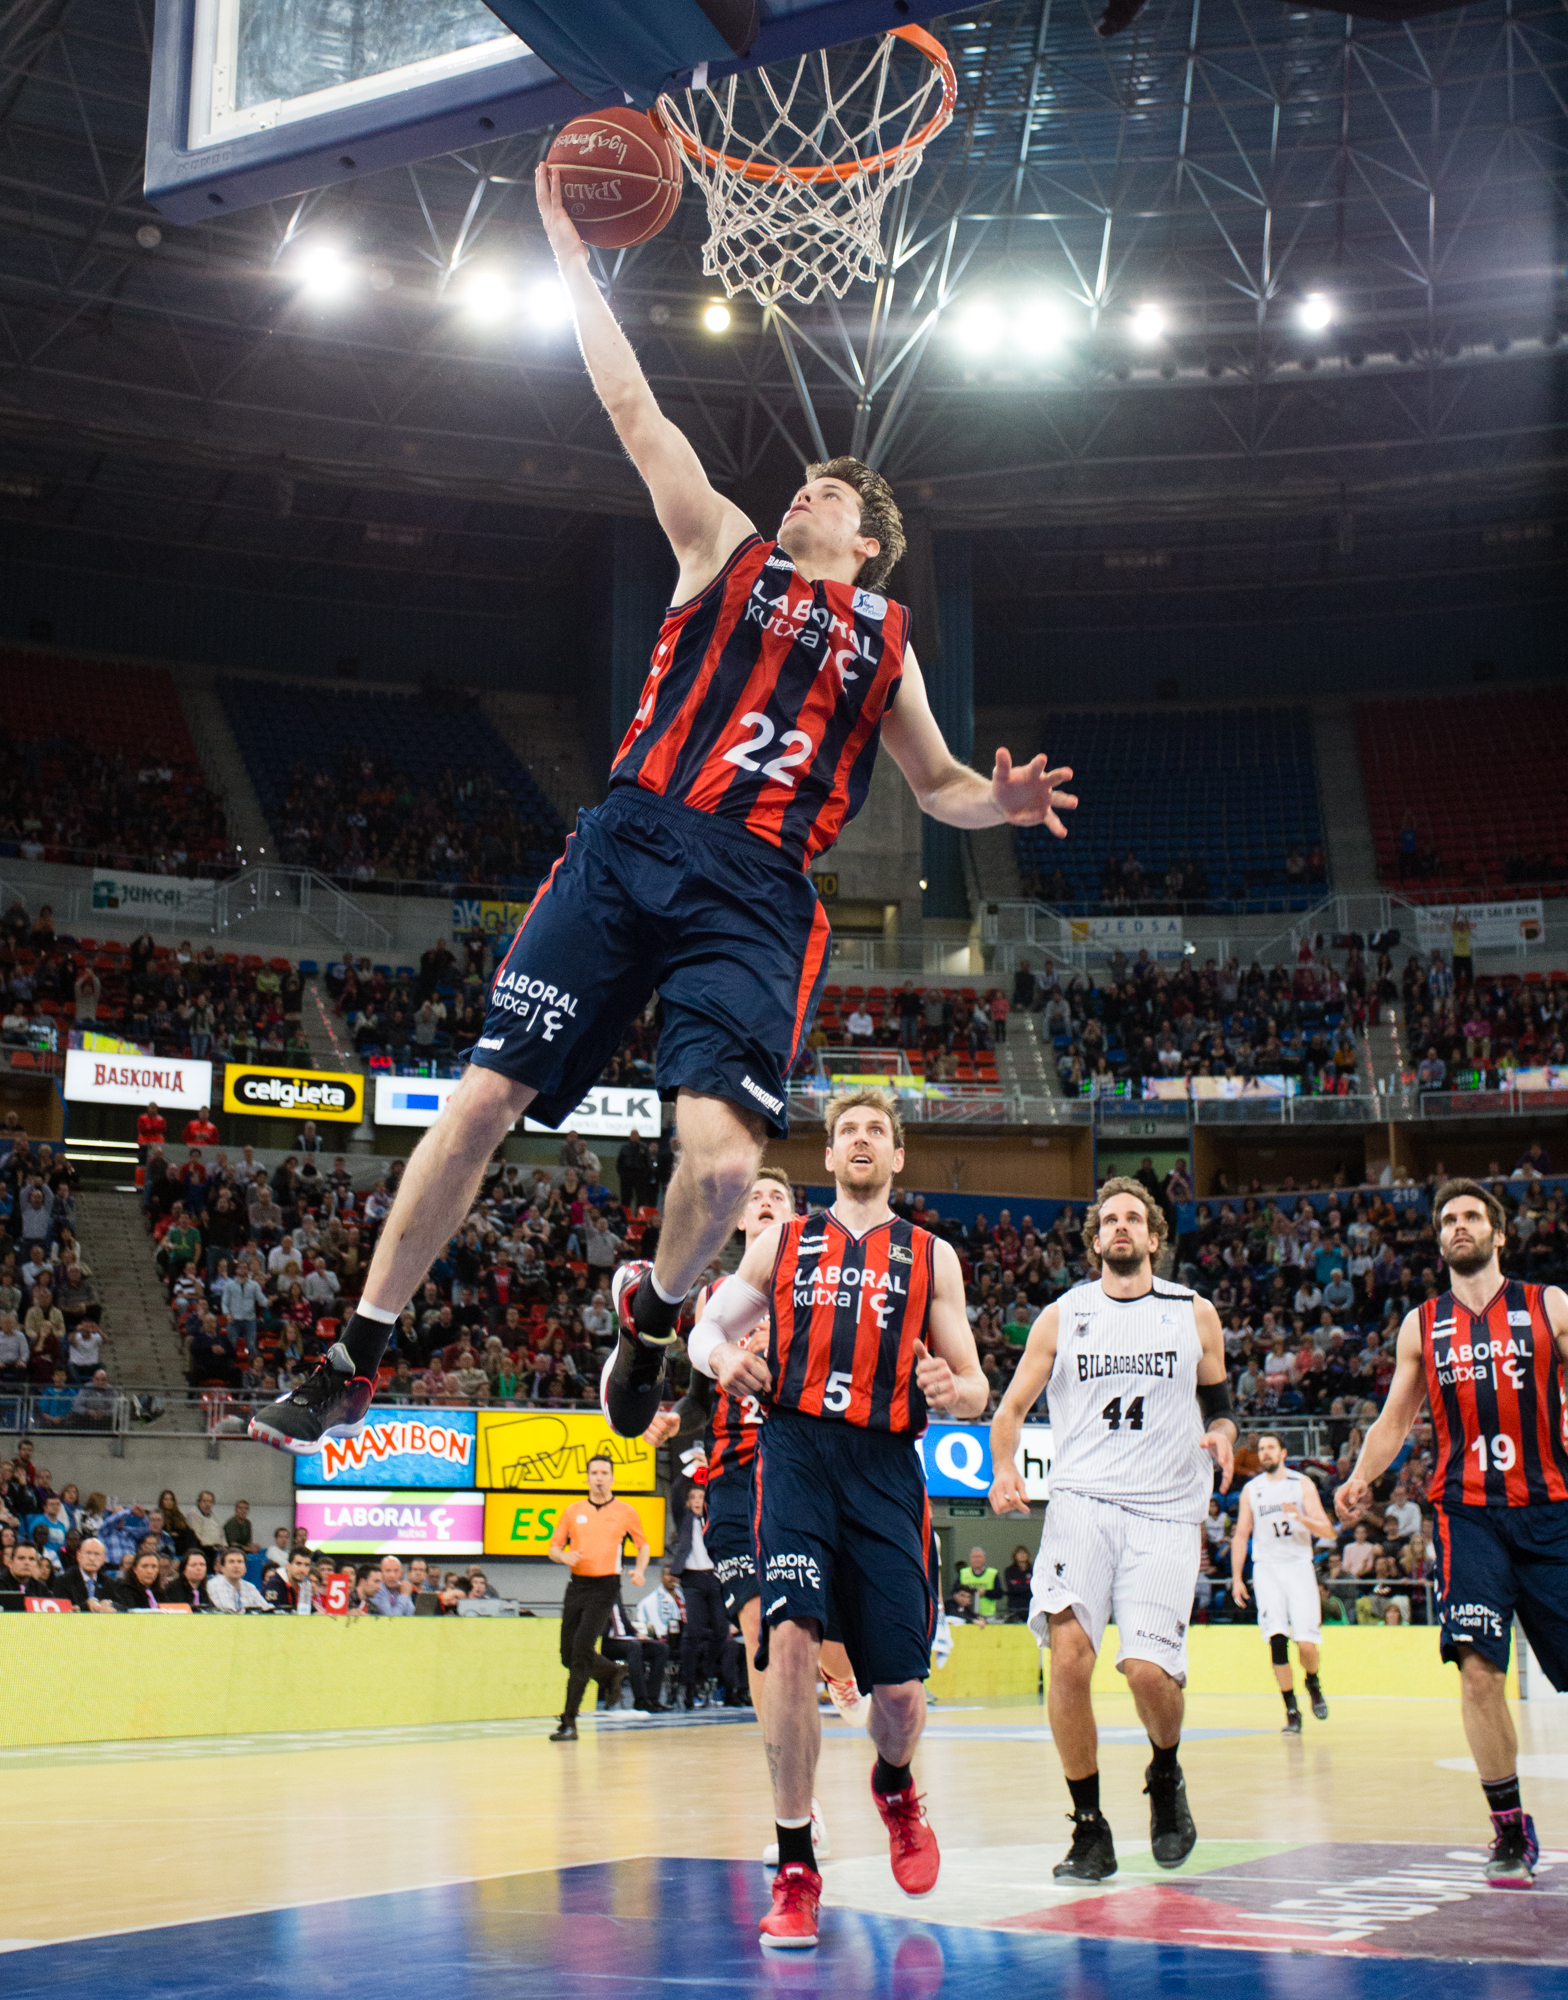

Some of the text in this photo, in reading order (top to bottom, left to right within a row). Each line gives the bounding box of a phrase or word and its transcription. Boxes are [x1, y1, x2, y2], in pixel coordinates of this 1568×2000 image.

[563, 179, 622, 201] SPALD
[744, 598, 819, 648] kutxa
[752, 579, 878, 665] LABORAL
[723, 711, 813, 787] 22
[814, 874, 838, 895] 10
[491, 989, 530, 1017] kutxa
[496, 969, 579, 1018] LABORAL
[94, 1063, 184, 1093] BASKONIA
[244, 1078, 345, 1108] celigüeta
[573, 1094, 653, 1118] SLK
[741, 1075, 785, 1115] BASKONIA
[794, 1266, 907, 1295] LABORAL
[793, 1289, 851, 1308] kutxa
[1077, 1351, 1177, 1382] BILBAOBASKET
[1434, 1338, 1533, 1368] LABORAL
[1438, 1365, 1488, 1386] kutxa
[823, 1371, 853, 1412] 5
[741, 1395, 768, 1424] 2
[1102, 1396, 1145, 1431] 44
[322, 1421, 471, 1480] MAXIBON
[914, 1432, 990, 1490] Q
[1024, 1449, 1051, 1479] h
[1471, 1433, 1517, 1472] 19
[324, 1508, 428, 1527] LABORAL
[1273, 1521, 1293, 1538] 12
[329, 1580, 346, 1609] 5
